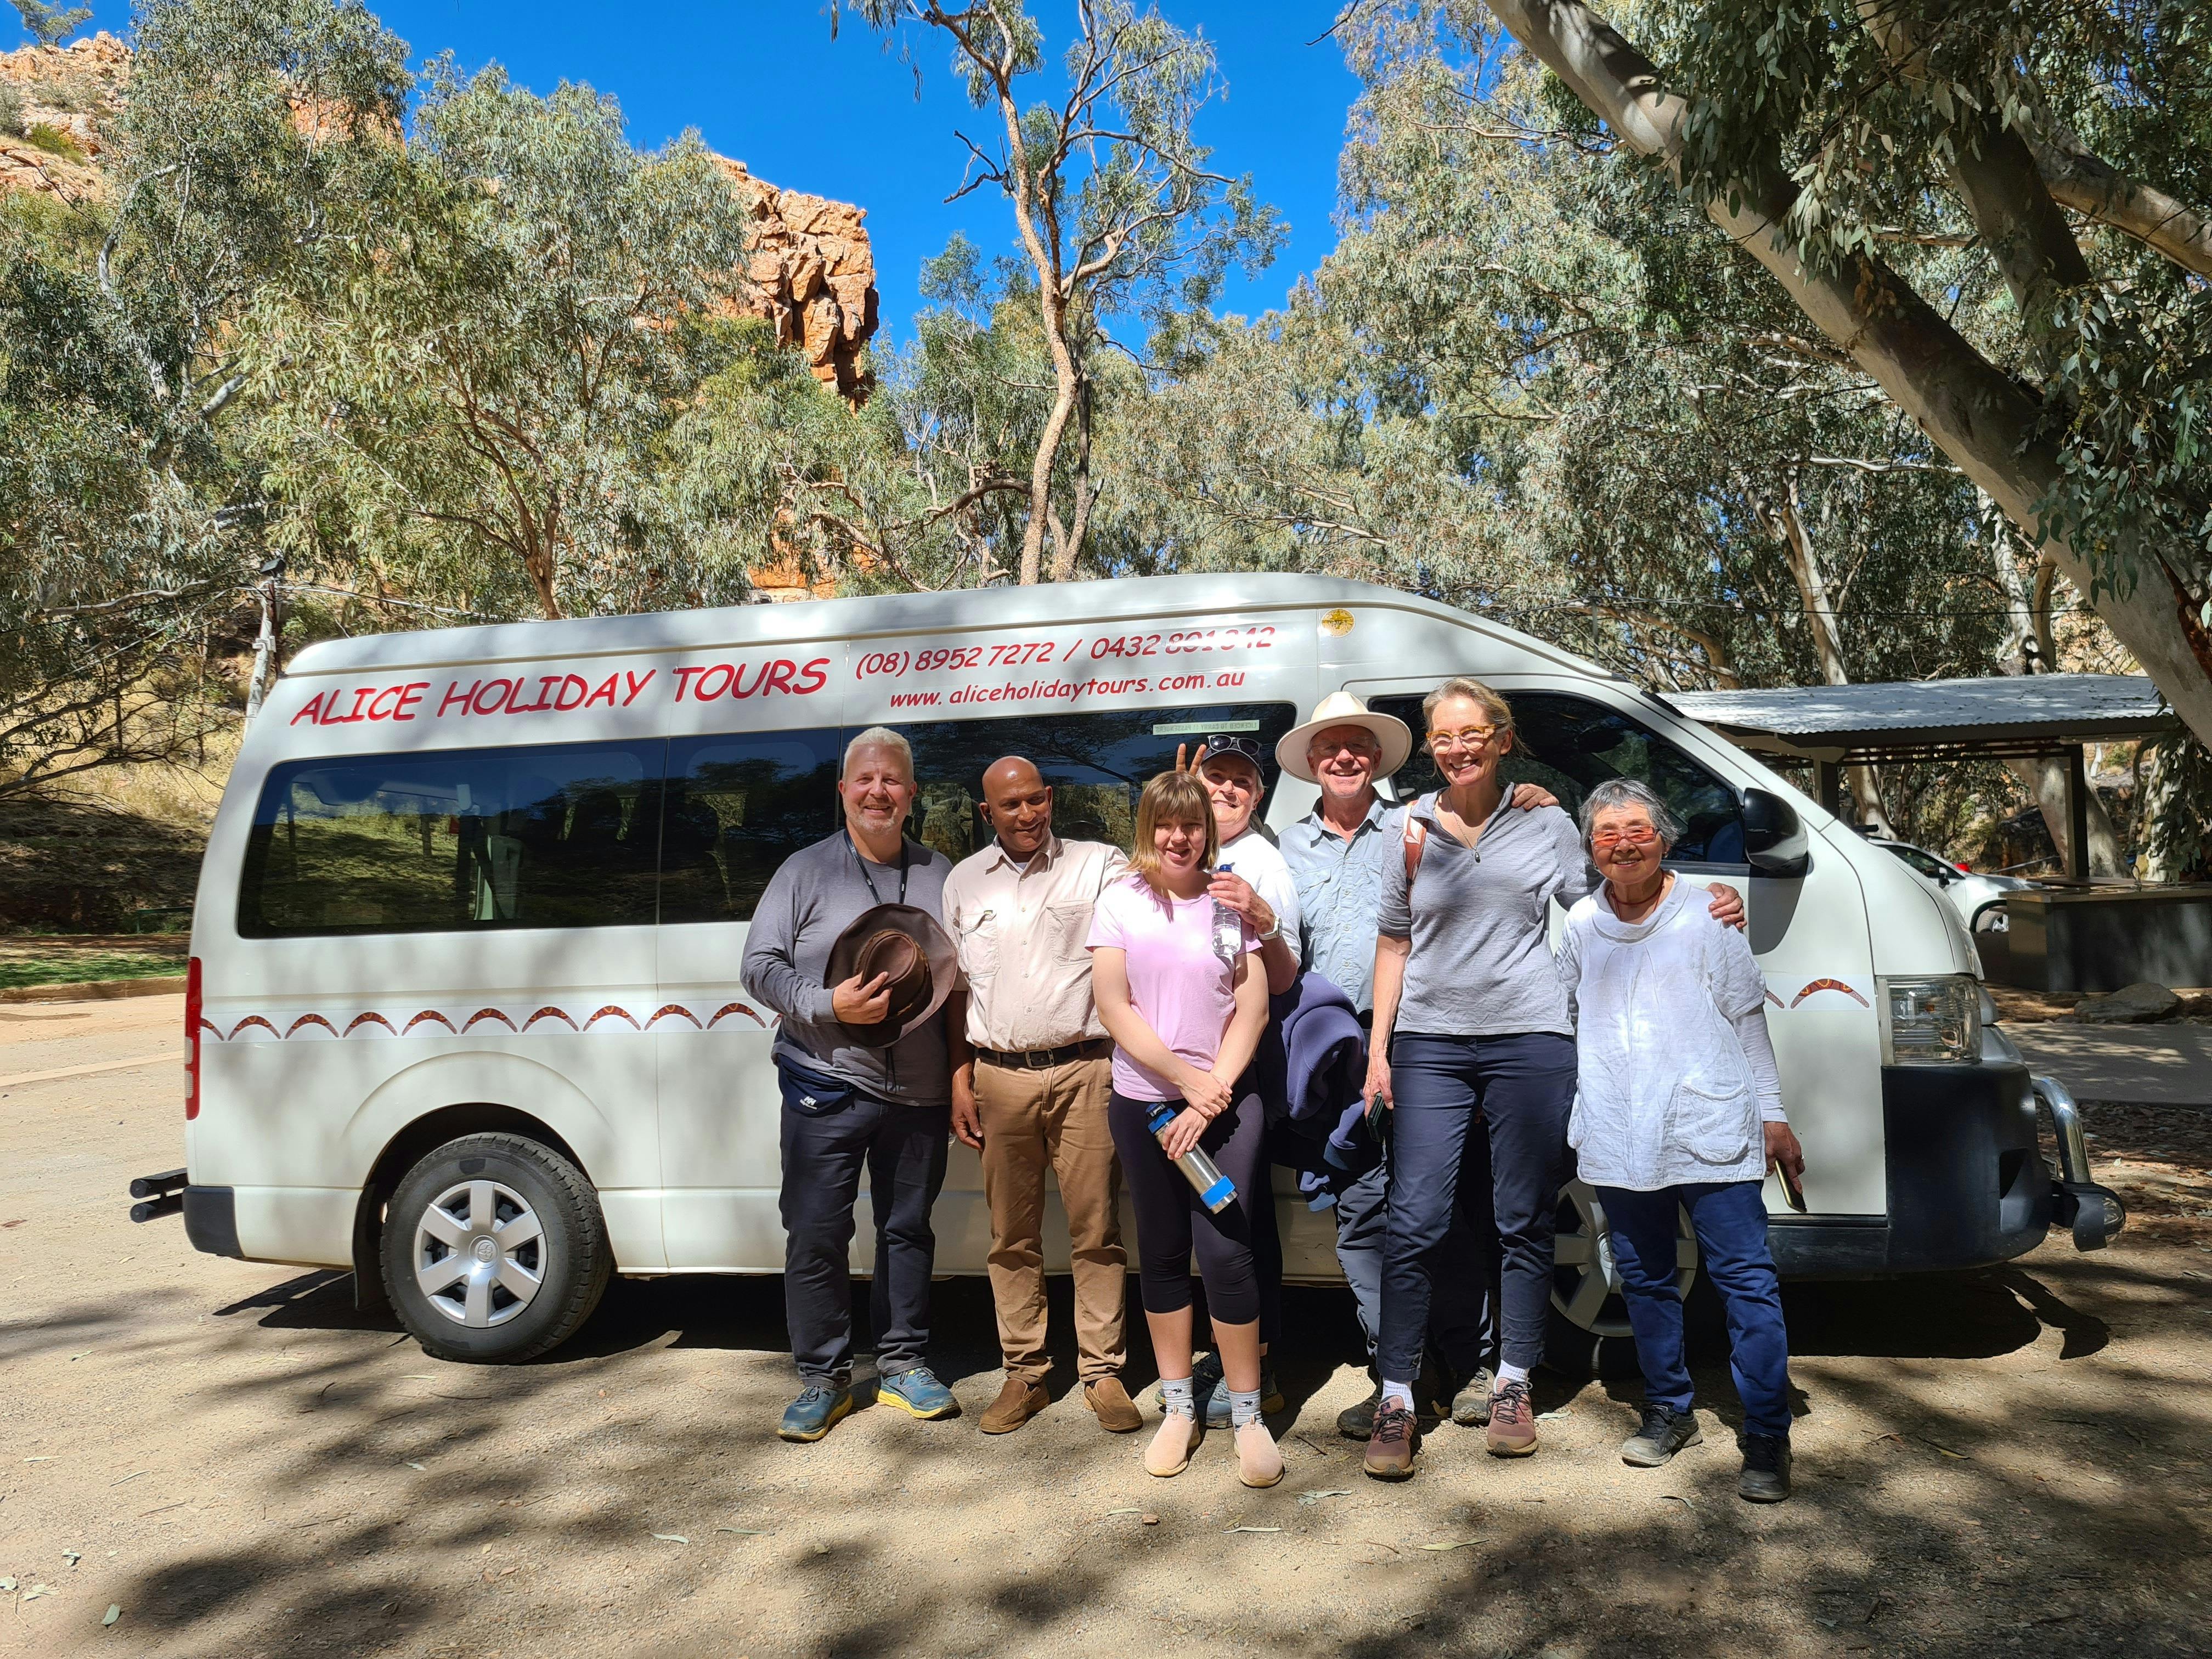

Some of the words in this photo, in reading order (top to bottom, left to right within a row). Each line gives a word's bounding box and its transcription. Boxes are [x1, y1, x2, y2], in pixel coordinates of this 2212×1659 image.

[856, 651, 910, 680] (08)
[914, 647, 984, 672] 8952
[988, 641, 1056, 667] 7272
[1063, 639, 1083, 662] /
[1091, 634, 1162, 659] 0432
[290, 682, 431, 726] ALICE
[437, 669, 657, 718] HOLIDAY
[673, 657, 831, 703] TOURS
